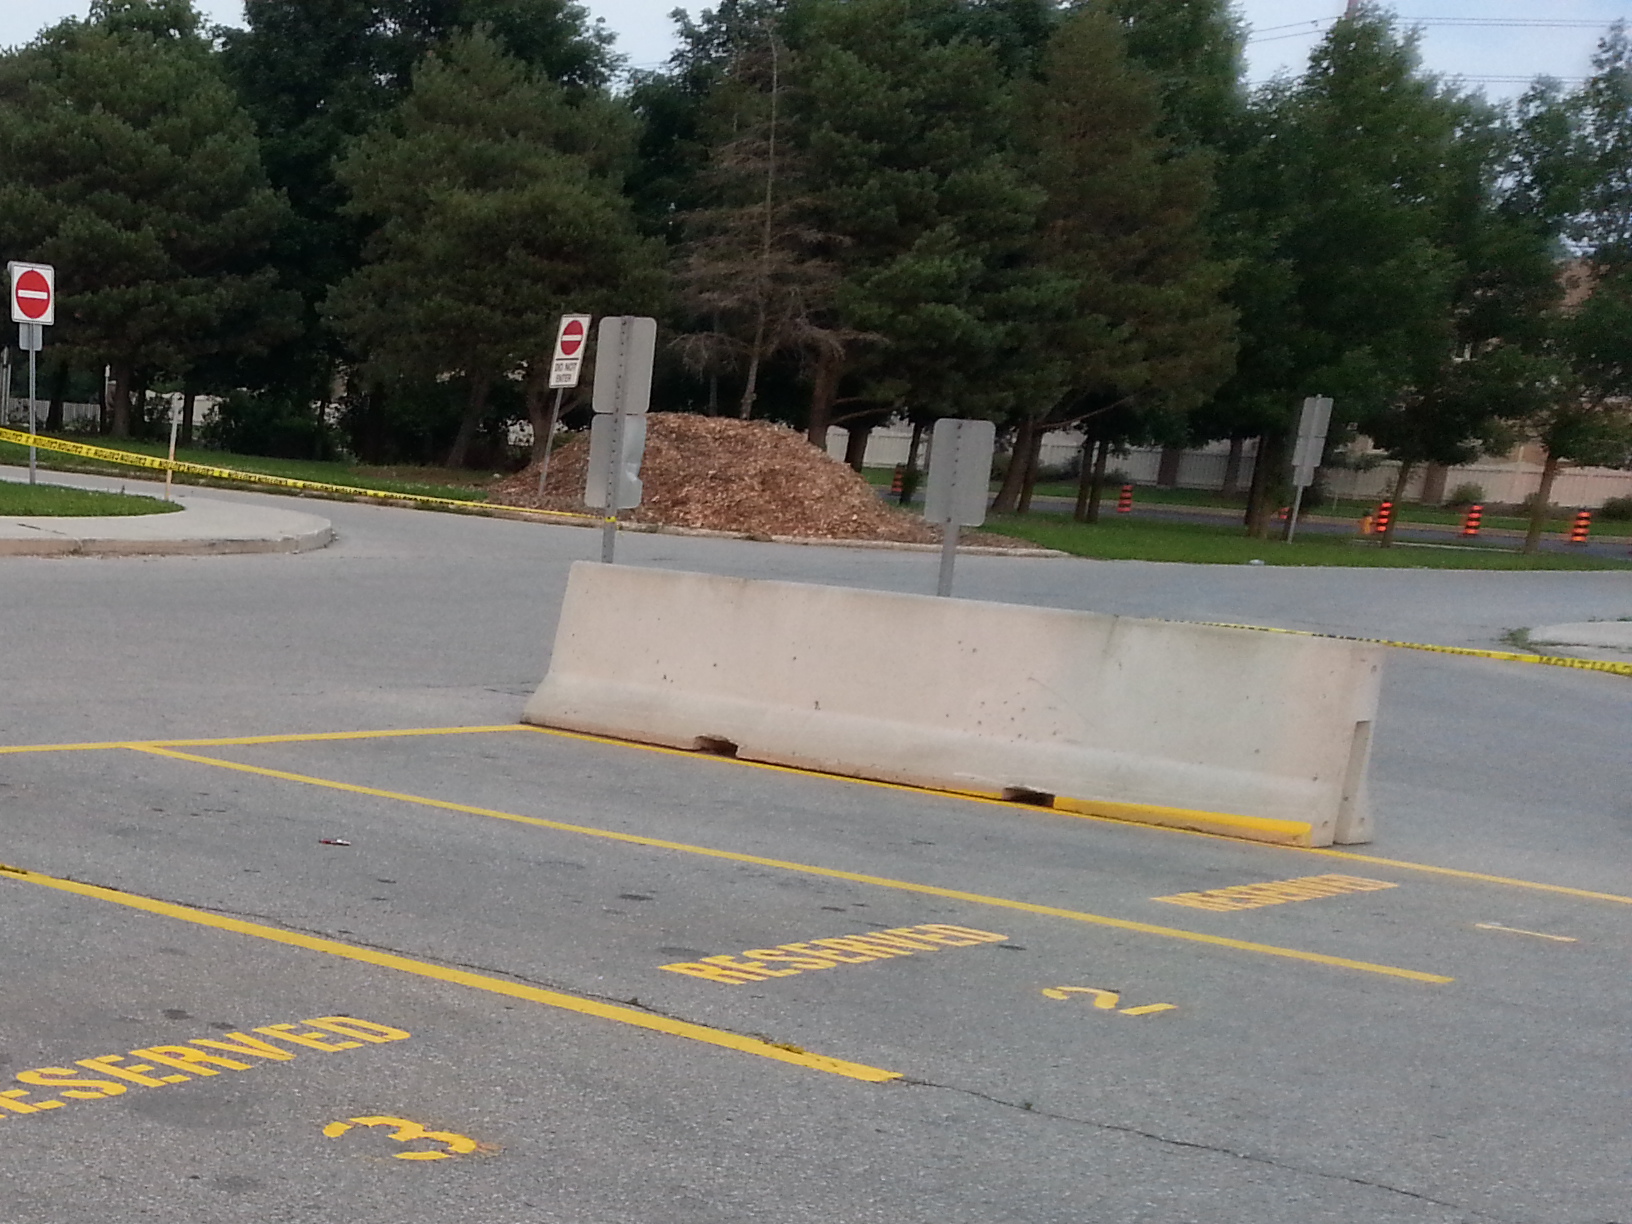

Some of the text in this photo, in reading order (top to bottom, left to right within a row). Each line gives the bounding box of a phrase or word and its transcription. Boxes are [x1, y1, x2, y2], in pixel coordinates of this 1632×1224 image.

[554, 362, 577, 372] DO NOT
[555, 373, 572, 383] ENTER
[657, 923, 1009, 985] RESERVED
[1042, 986, 1178, 1015] 2
[323, 1116, 477, 1160] 3
